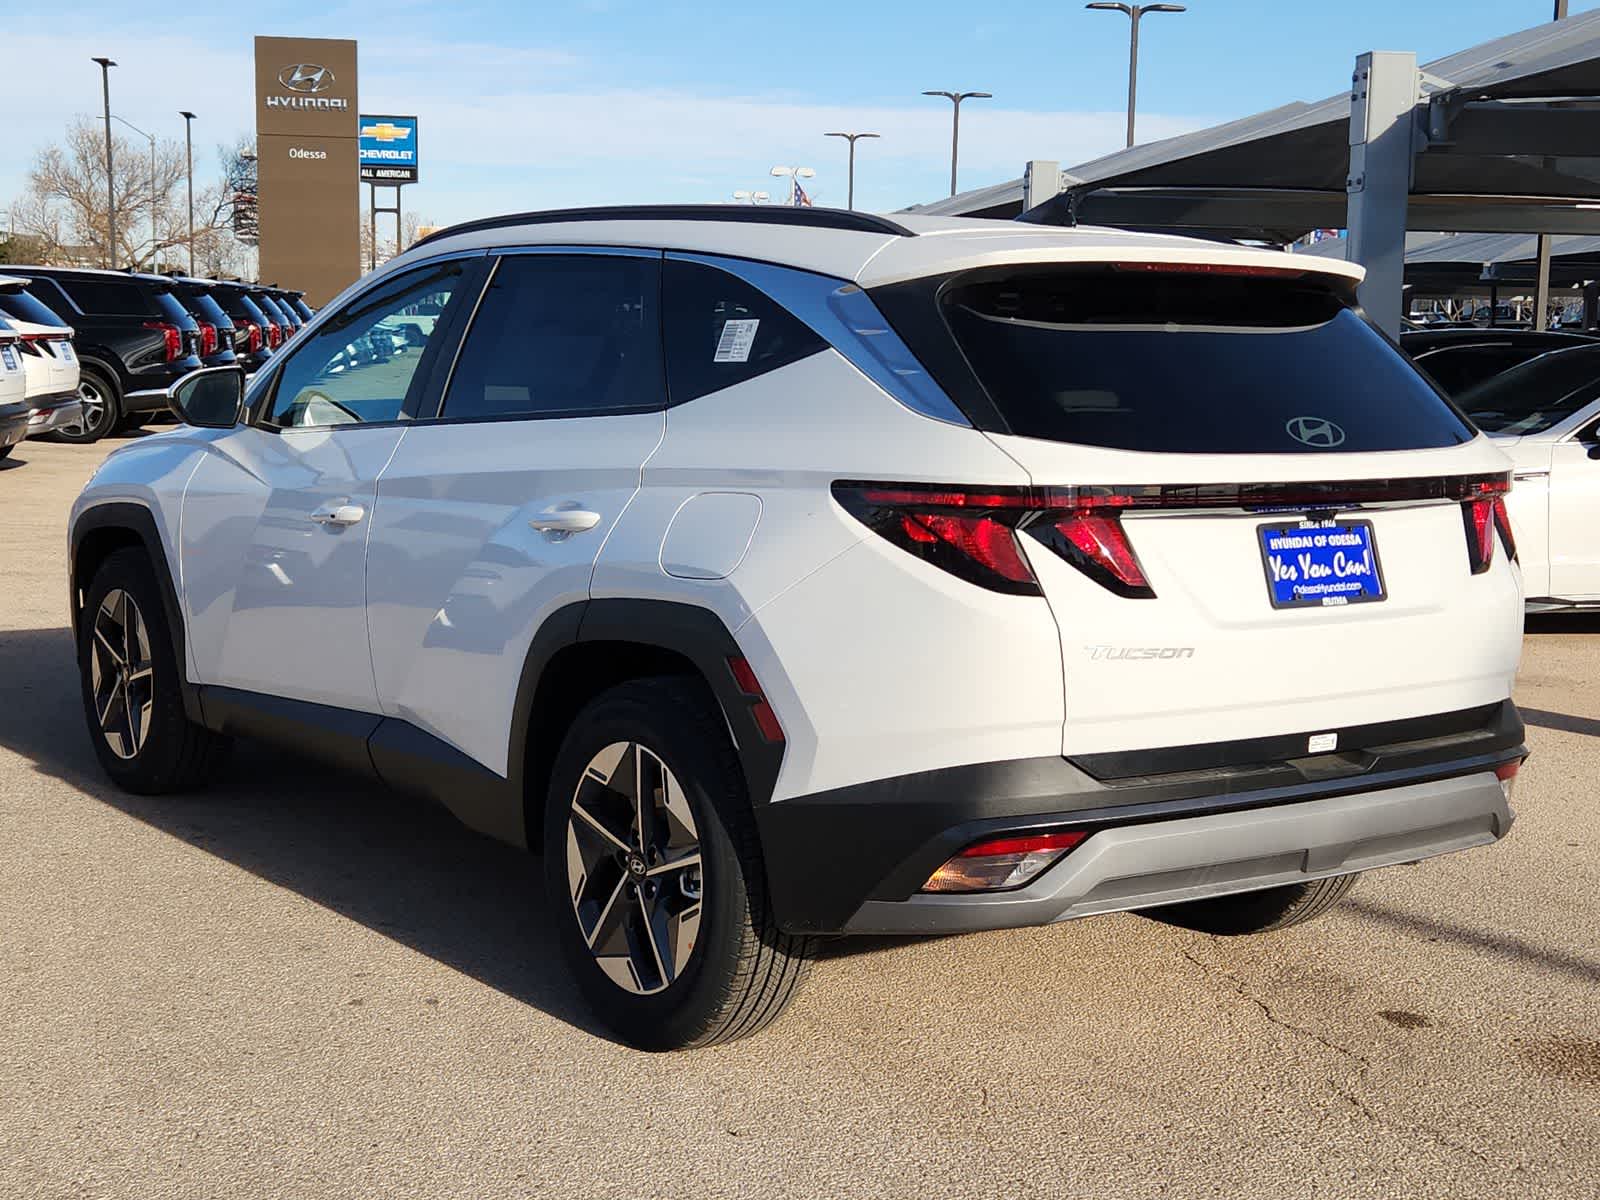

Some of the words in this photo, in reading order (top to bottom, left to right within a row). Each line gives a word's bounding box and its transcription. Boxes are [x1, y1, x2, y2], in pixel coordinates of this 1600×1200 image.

[266, 96, 347, 108] HYUNDAI
[289, 148, 327, 160] Odessa
[359, 149, 413, 160] CHEVROLET
[361, 168, 374, 177] ALL
[376, 169, 411, 179] AMERICAN
[1270, 536, 1313, 549] HYUNDAI
[1314, 535, 1327, 547] OF
[1328, 533, 1362, 546] ODESSA
[1269, 555, 1298, 581] Yes
[1297, 552, 1332, 580] You
[1333, 549, 1371, 578] Can!
